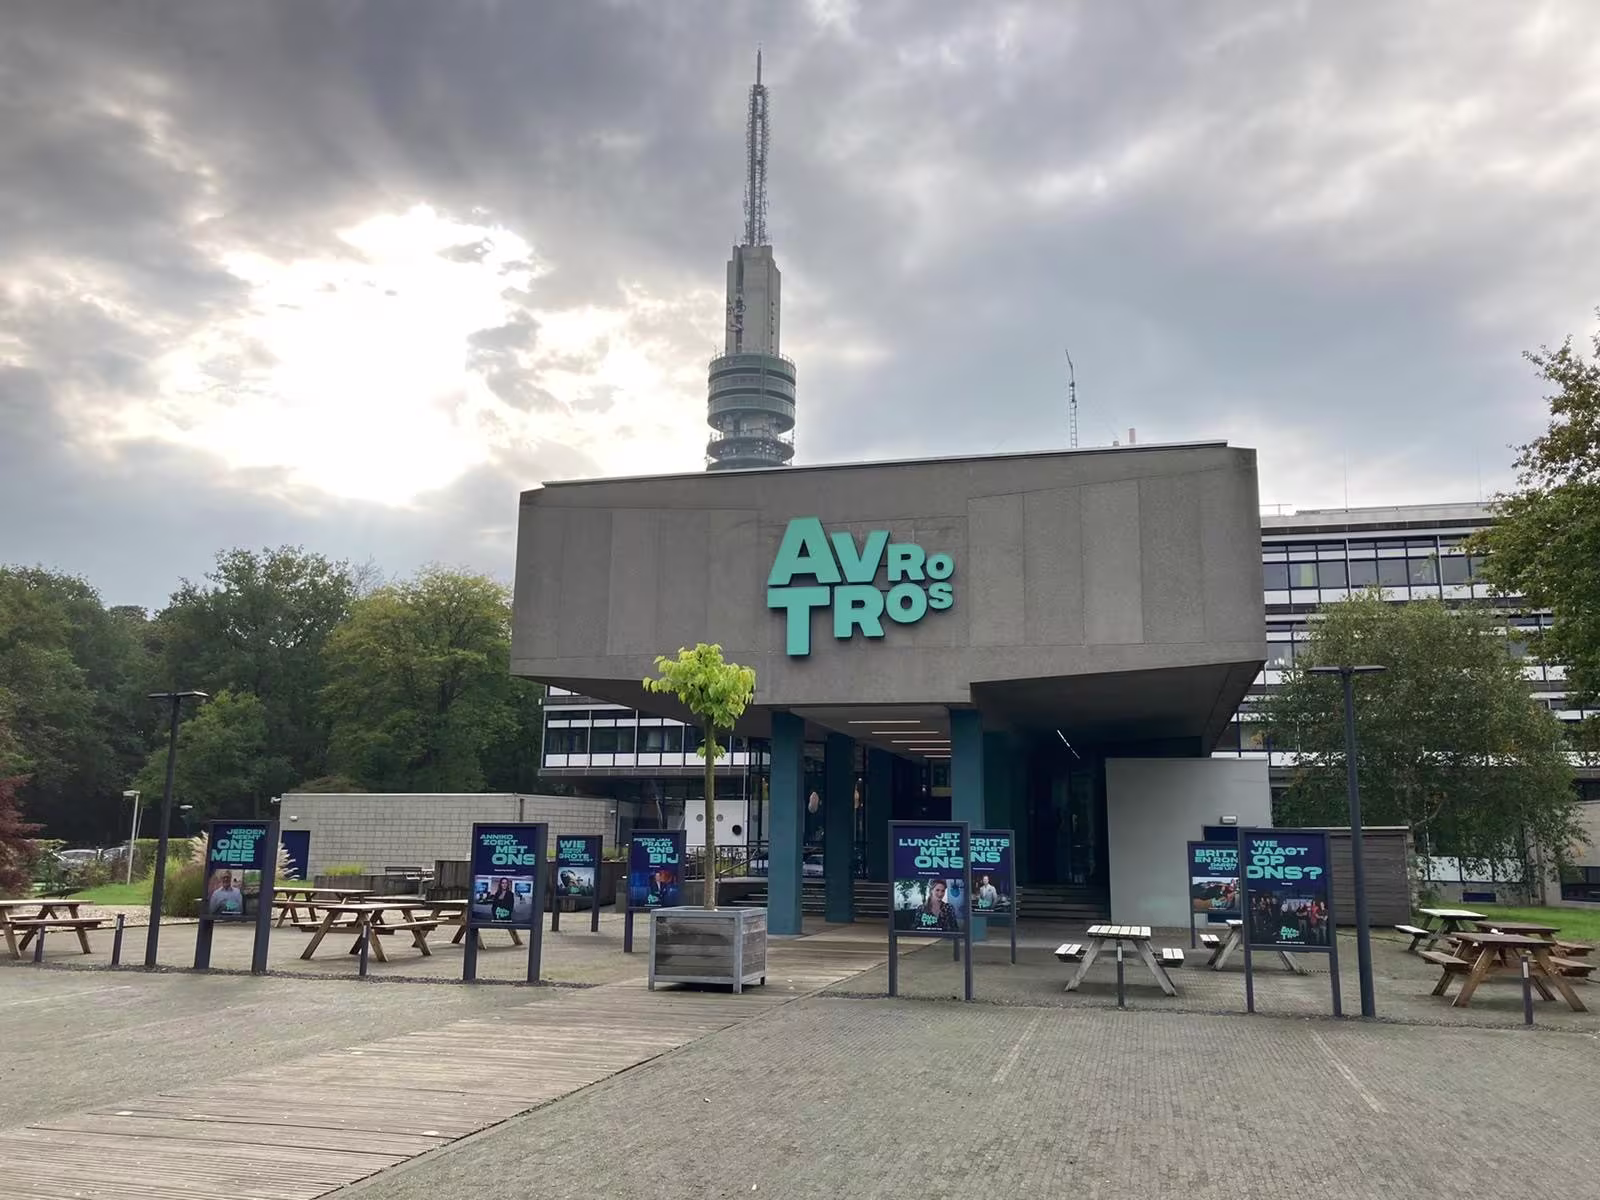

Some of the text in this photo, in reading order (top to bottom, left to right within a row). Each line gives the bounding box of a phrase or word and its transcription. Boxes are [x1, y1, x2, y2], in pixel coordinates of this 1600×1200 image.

[767, 582, 954, 656] TROS
[217, 839, 254, 850] ONS
[560, 840, 586, 848] WIE
[899, 838, 960, 847] LUNCHT
[495, 845, 528, 854] MET
[646, 846, 674, 854] ONS
[920, 846, 960, 856] MET
[1195, 849, 1238, 858] BRITT
[1250, 847, 1309, 856] JAAGT
[211, 849, 255, 862] MEE
[491, 853, 536, 866] ONS
[649, 853, 679, 864] BIJ
[970, 851, 1001, 863] NS
[1252, 855, 1285, 866] OP
[914, 856, 964, 869] ONS
[1246, 866, 1323, 880] ONS?
